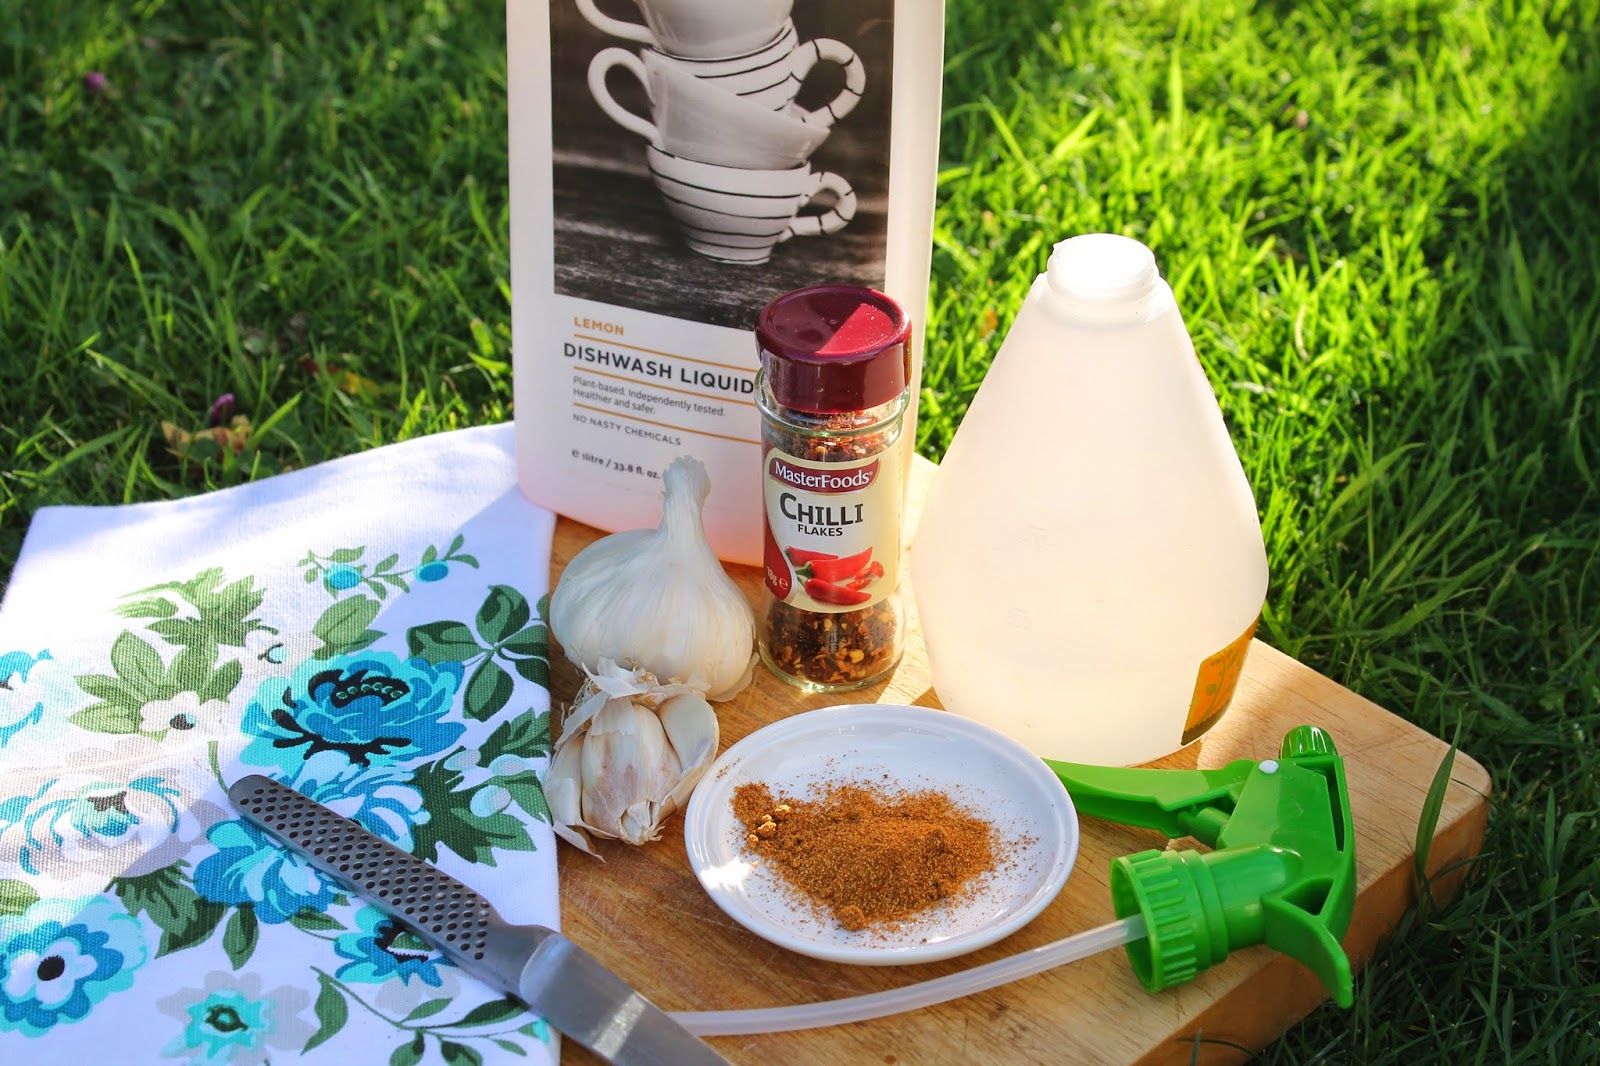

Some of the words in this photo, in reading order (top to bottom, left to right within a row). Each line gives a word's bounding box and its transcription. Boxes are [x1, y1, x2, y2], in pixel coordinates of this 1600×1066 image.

[574, 316, 625, 336] LEMON
[563, 342, 672, 379] DISHWASH
[680, 367, 754, 394] LIQUID
[573, 375, 626, 396] Plant-based.
[628, 388, 692, 412] Independently
[693, 402, 725, 417] tested.
[573, 388, 612, 404] Healthier
[614, 398, 630, 409] and
[632, 401, 656, 415] safer.
[572, 413, 587, 424] NO
[589, 415, 622, 432] NASTY
[624, 426, 682, 446] CHEMICALS
[613, 462, 634, 473] 33.8
[646, 470, 661, 479] oz.
[775, 460, 870, 489] MasterFoods
[779, 492, 864, 526] CHILLI
[797, 524, 843, 537] FLAKES
